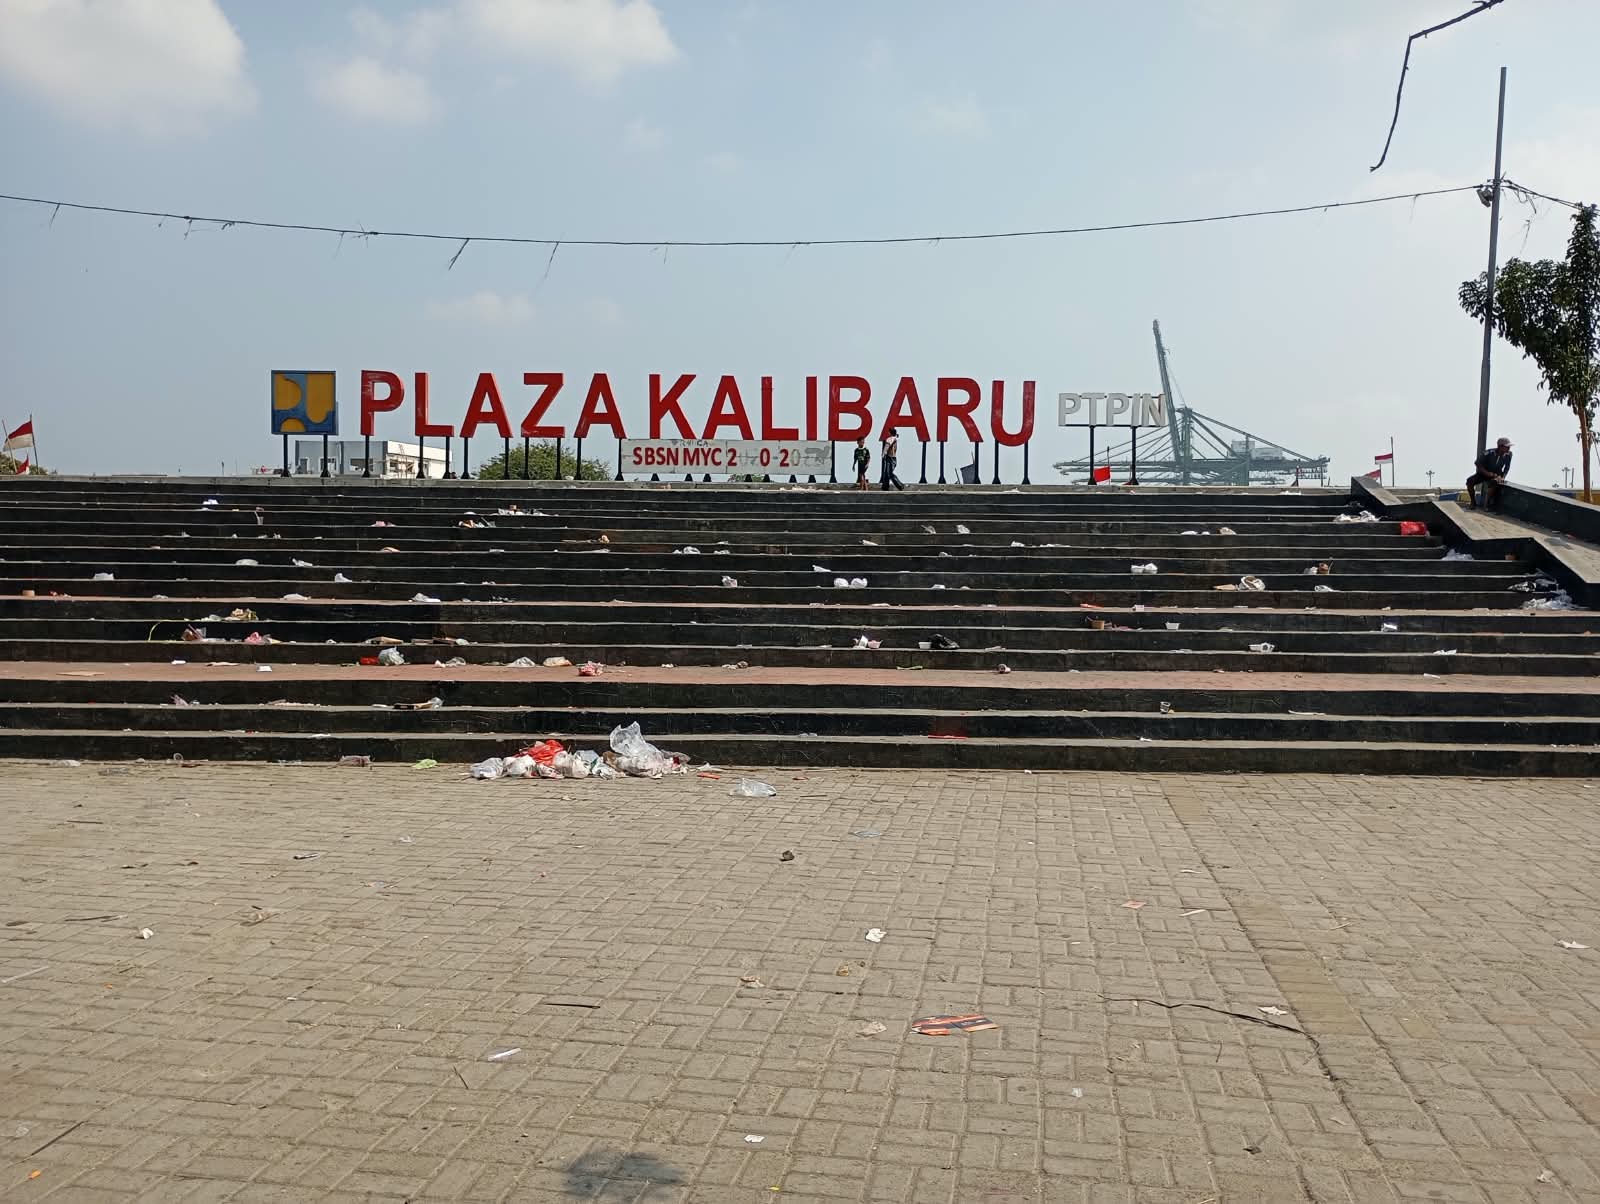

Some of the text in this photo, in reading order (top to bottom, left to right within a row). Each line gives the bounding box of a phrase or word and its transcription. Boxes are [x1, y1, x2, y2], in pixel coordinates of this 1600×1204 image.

[361, 370, 1036, 446] PLAZA KALIBARU
[633, 447, 679, 466] SBSN
[683, 448, 722, 466] MYC
